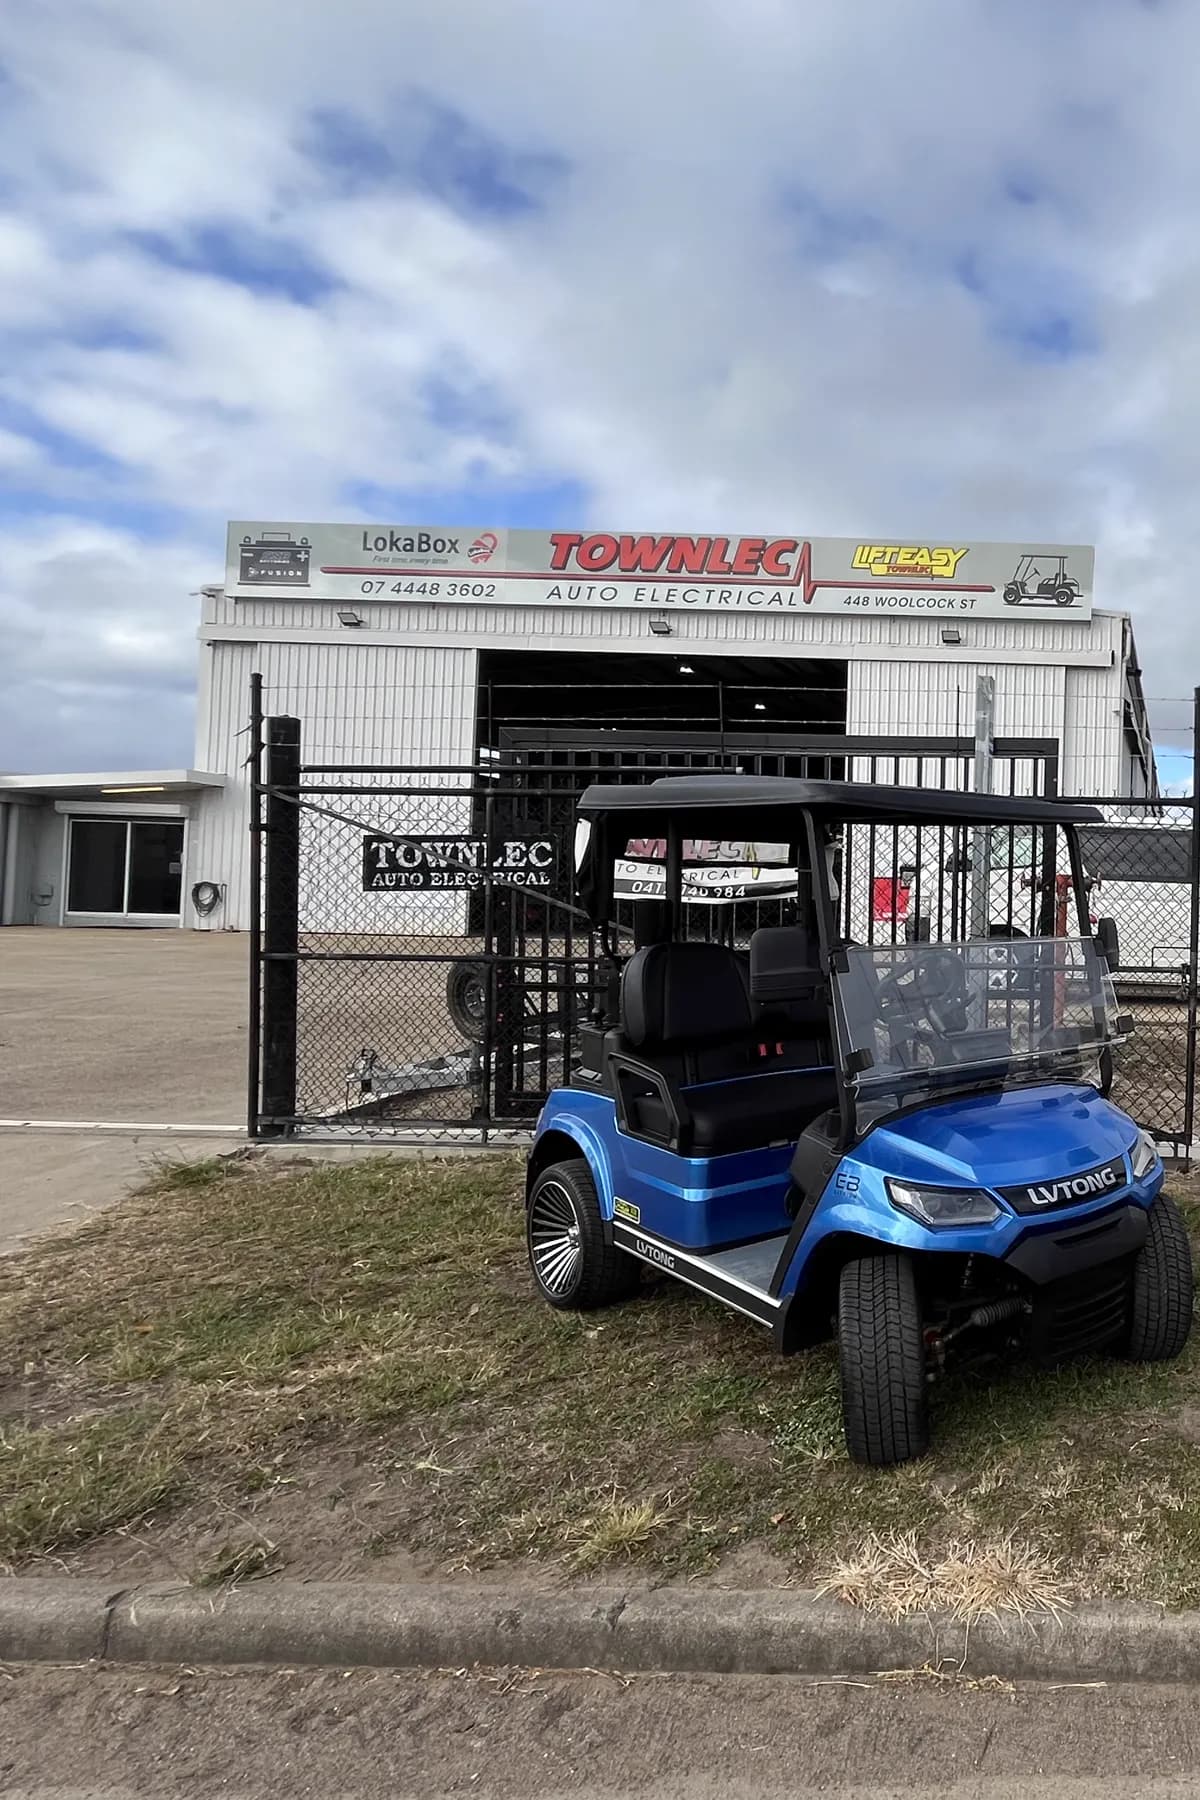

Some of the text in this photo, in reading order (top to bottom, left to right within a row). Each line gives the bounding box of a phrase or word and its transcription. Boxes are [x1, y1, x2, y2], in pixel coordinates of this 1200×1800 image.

[362, 531, 460, 554] LokaBox
[551, 533, 799, 577] TOWNLEC
[361, 580, 497, 598] 07 4448 3602
[546, 585, 798, 607] AUTO ELECTRICAL
[843, 596, 977, 609] 448 WOOLCOCK ST
[372, 872, 424, 886] AUTO
[713, 885, 745, 898] 984
[1027, 1167, 1117, 1205] LVTONG
[636, 1239, 675, 1270] LVTONG
